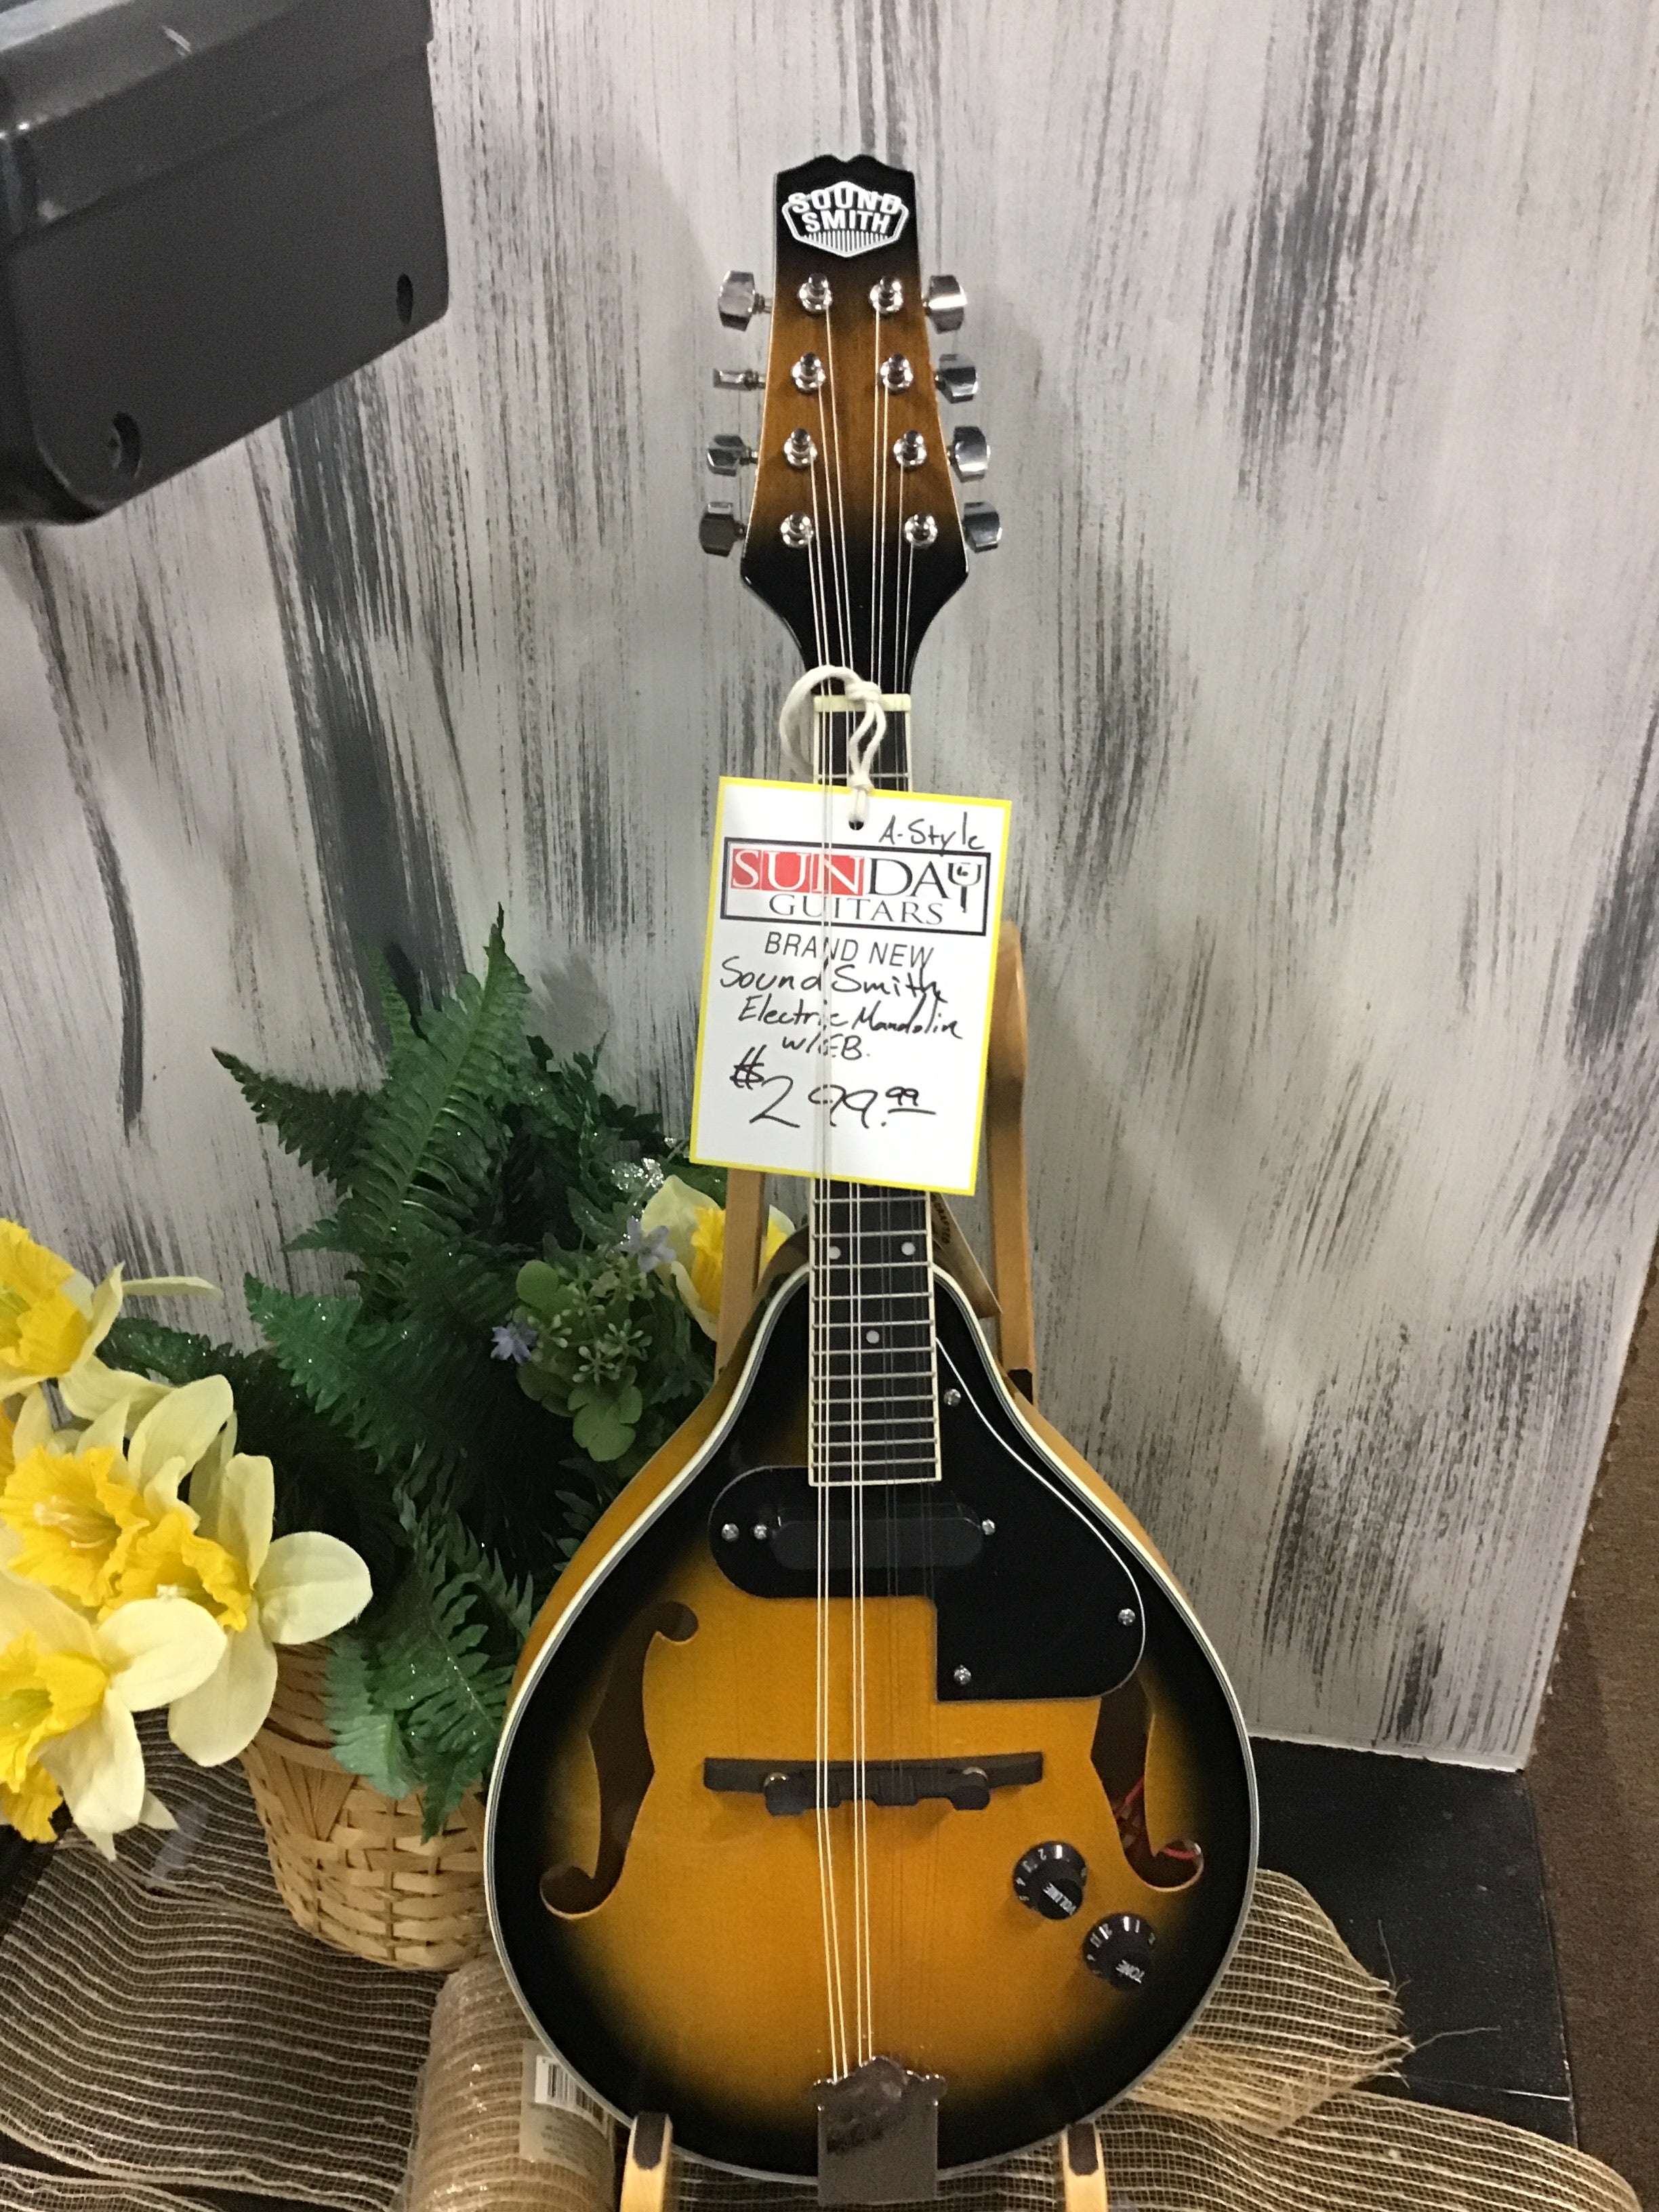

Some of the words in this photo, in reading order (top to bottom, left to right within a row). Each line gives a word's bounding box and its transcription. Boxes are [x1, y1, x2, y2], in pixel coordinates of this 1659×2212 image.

[788, 187, 902, 215] SOUND
[801, 209, 890, 233] SMITH
[731, 848, 983, 914] SUNDAY
[769, 893, 943, 926] GUITARS
[764, 931, 859, 962] BRAND
[869, 941, 935, 970] NEW
[737, 993, 848, 1027] Electric
